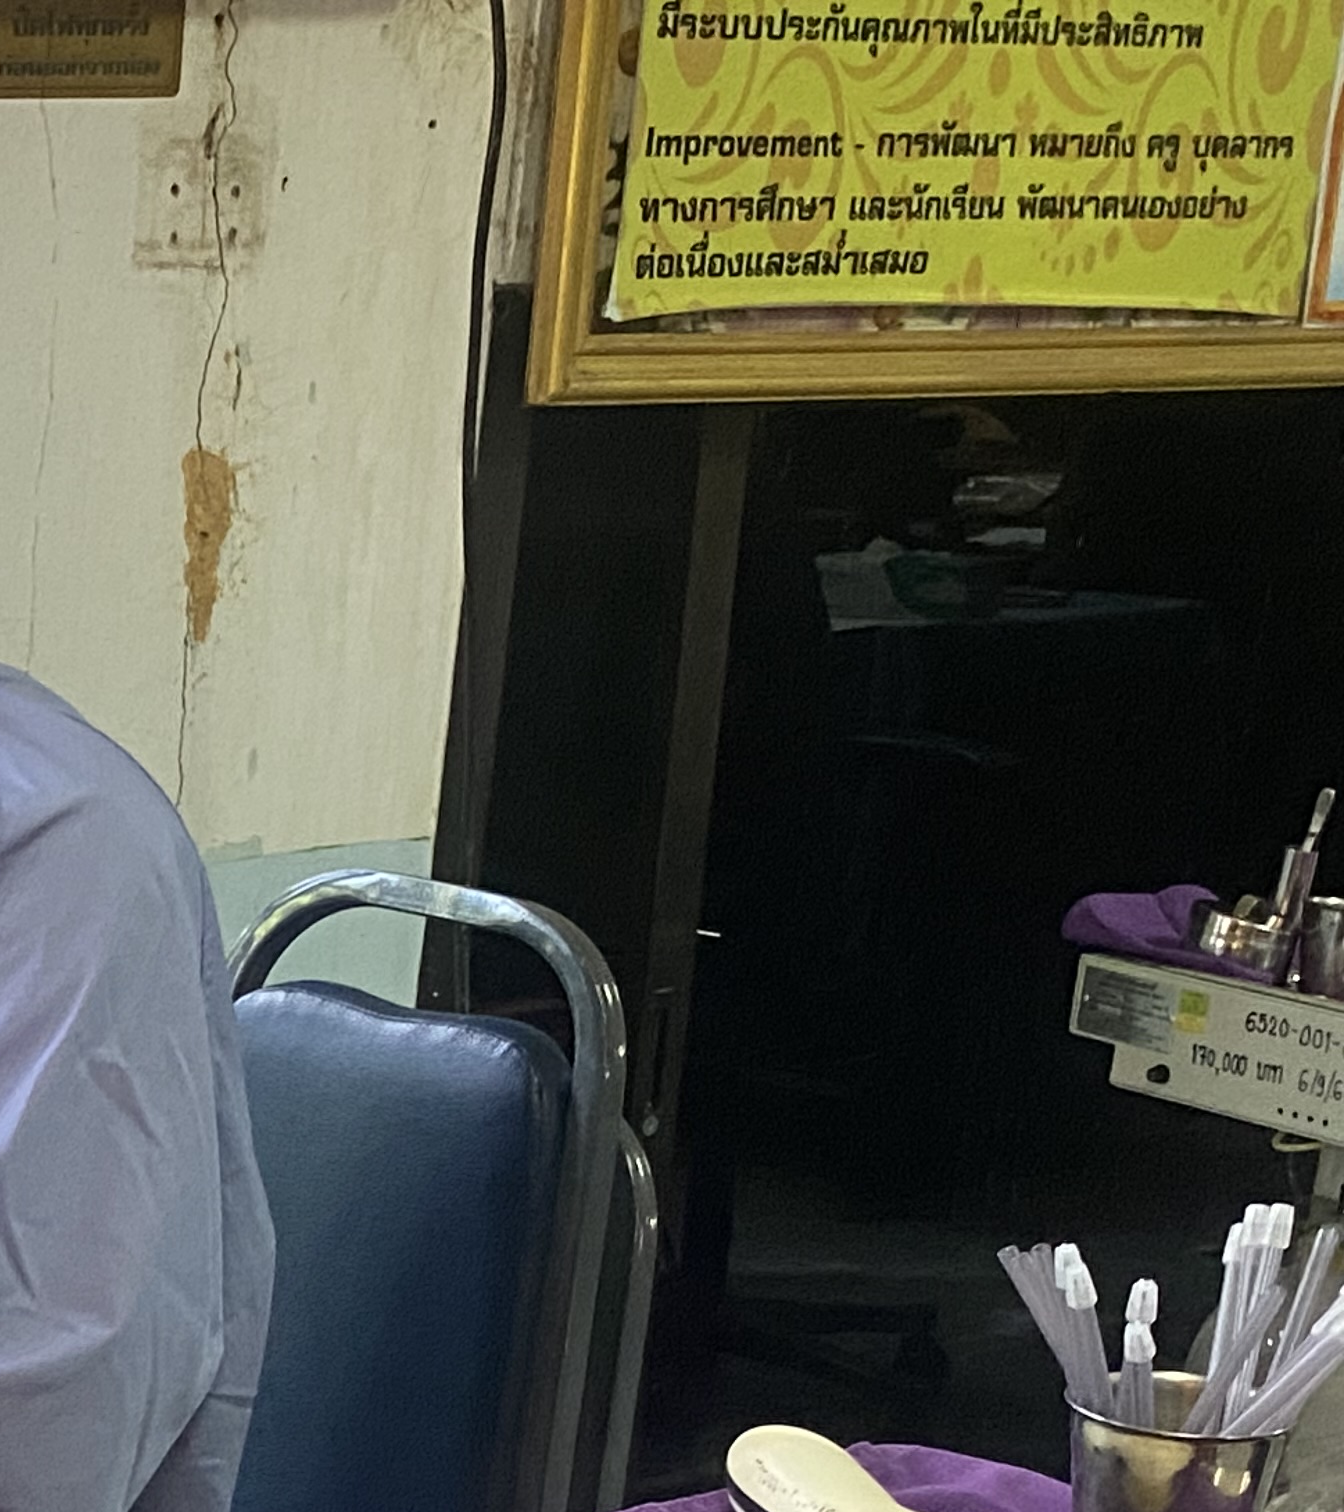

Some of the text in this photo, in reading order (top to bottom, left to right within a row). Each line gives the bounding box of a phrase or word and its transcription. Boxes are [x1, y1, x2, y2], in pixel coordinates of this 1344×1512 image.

[645, 127, 843, 165] Improvement
[877, 120, 1016, 157] การพัฒนา
[1029, 121, 1136, 157] หมายถึง
[1147, 134, 1180, 172] ครู
[1192, 134, 1294, 175] บุคลากร
[640, 183, 835, 222] ทางการศึกษา
[849, 183, 1004, 220] และนักเรียน
[1245, 1011, 1344, 1059] 6520-001-
